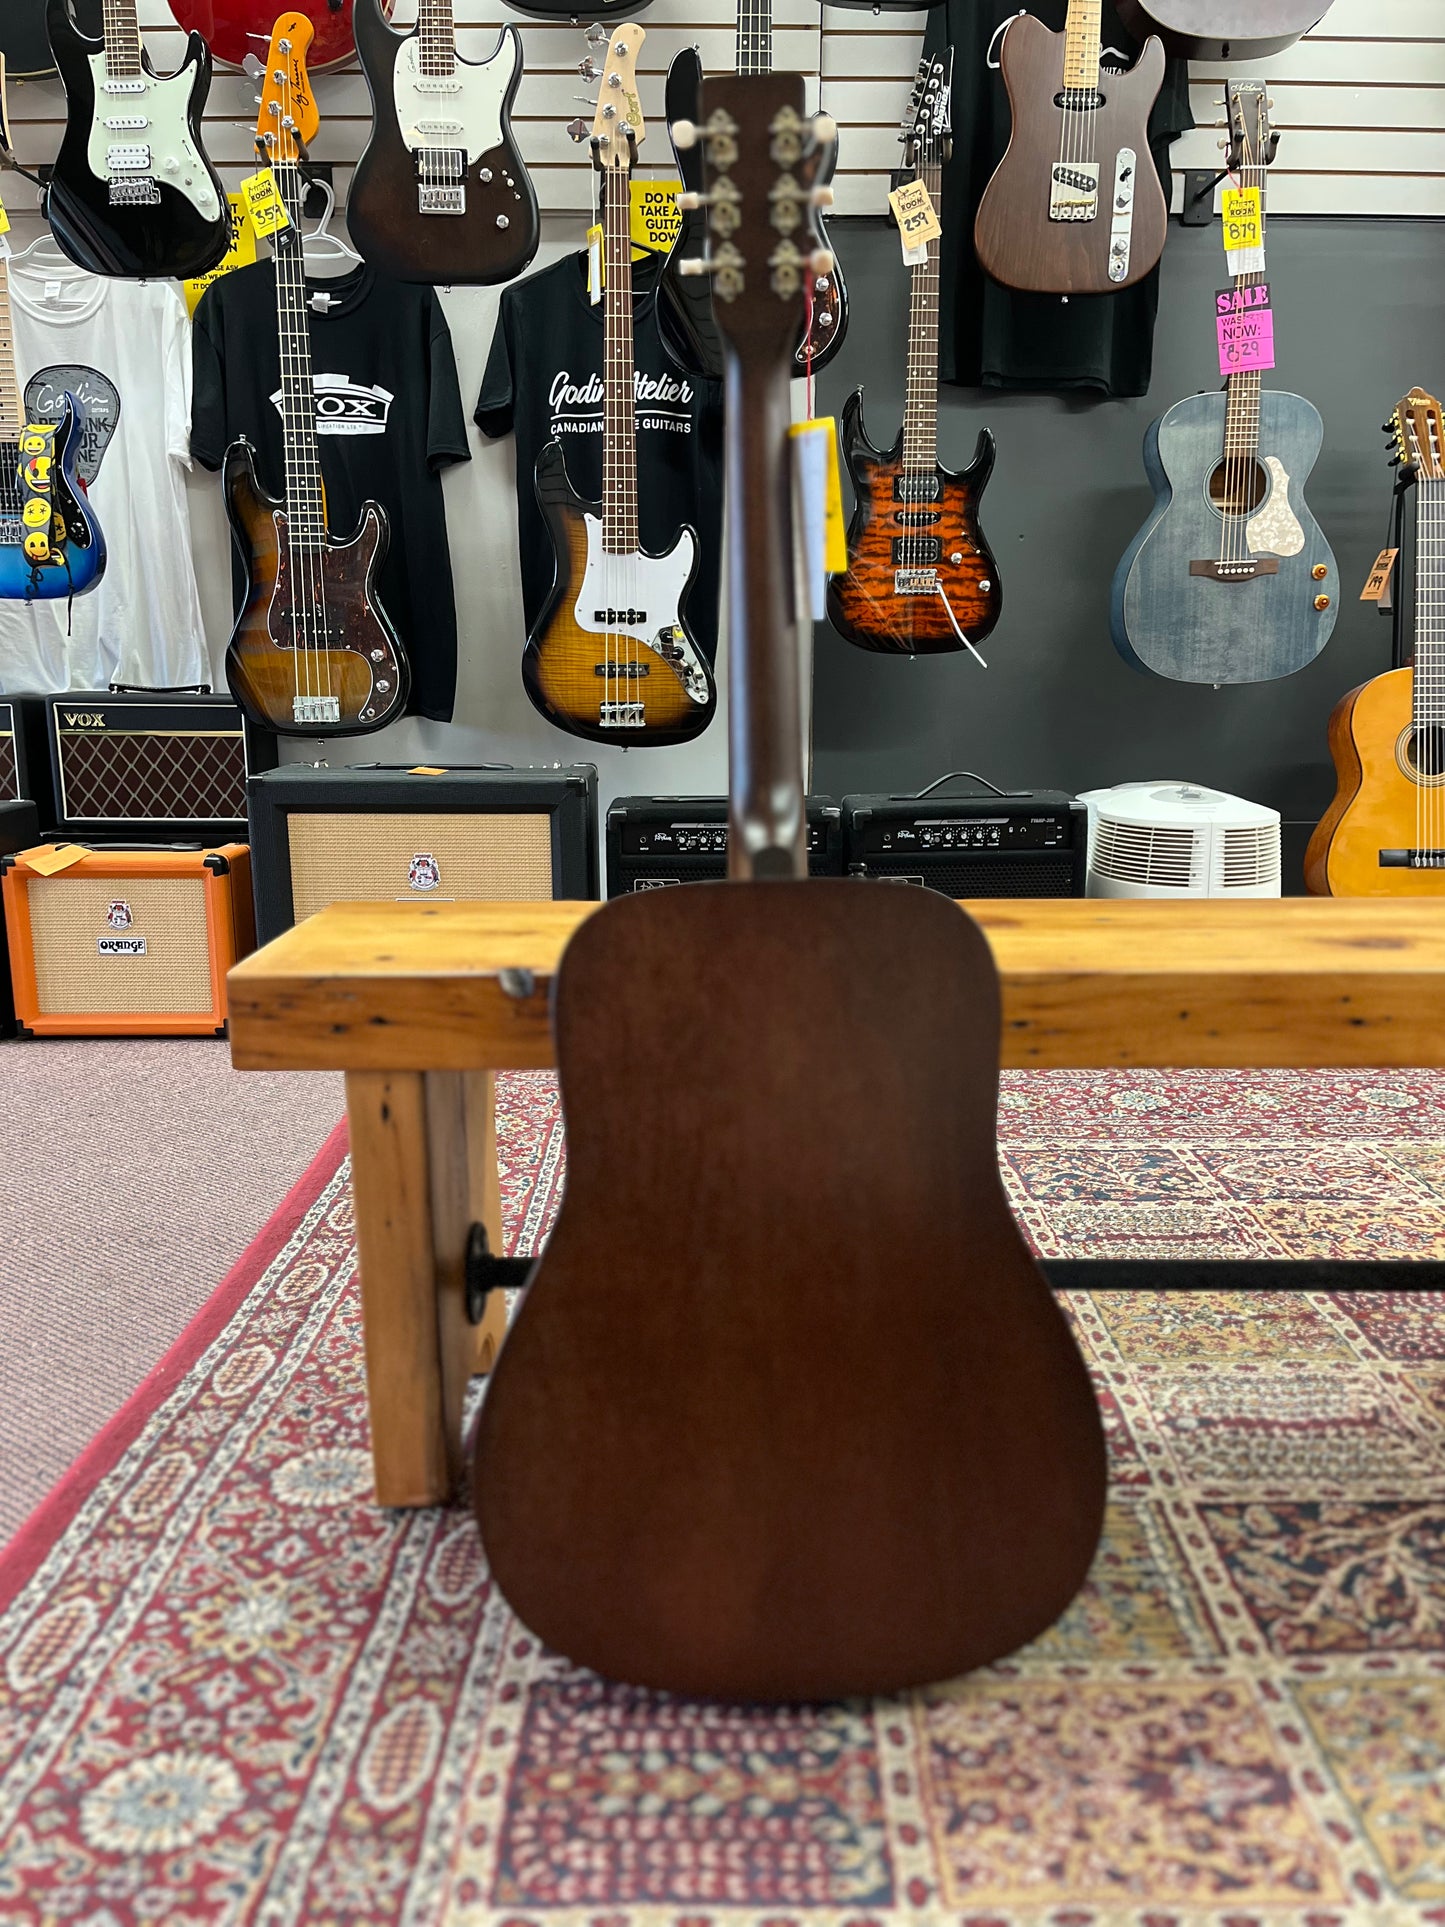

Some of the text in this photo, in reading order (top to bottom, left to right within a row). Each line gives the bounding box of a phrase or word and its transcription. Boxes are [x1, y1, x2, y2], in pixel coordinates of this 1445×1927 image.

[932, 86, 950, 135] Ibanez
[250, 187, 273, 202] ROOM
[645, 193, 663, 203] DO
[639, 206, 669, 216] TAKE
[901, 197, 924, 211] ROOM
[1230, 208, 1255, 216] ROOM
[645, 219, 683, 229] GUITA
[650, 232, 677, 242] DOW
[1216, 285, 1269, 314] SALE
[1223, 324, 1261, 341] NOW:
[314, 396, 377, 417] OX
[643, 419, 692, 433] GUITARS
[63, 713, 106, 727] VOX
[100, 941, 144, 952] ORANGE
